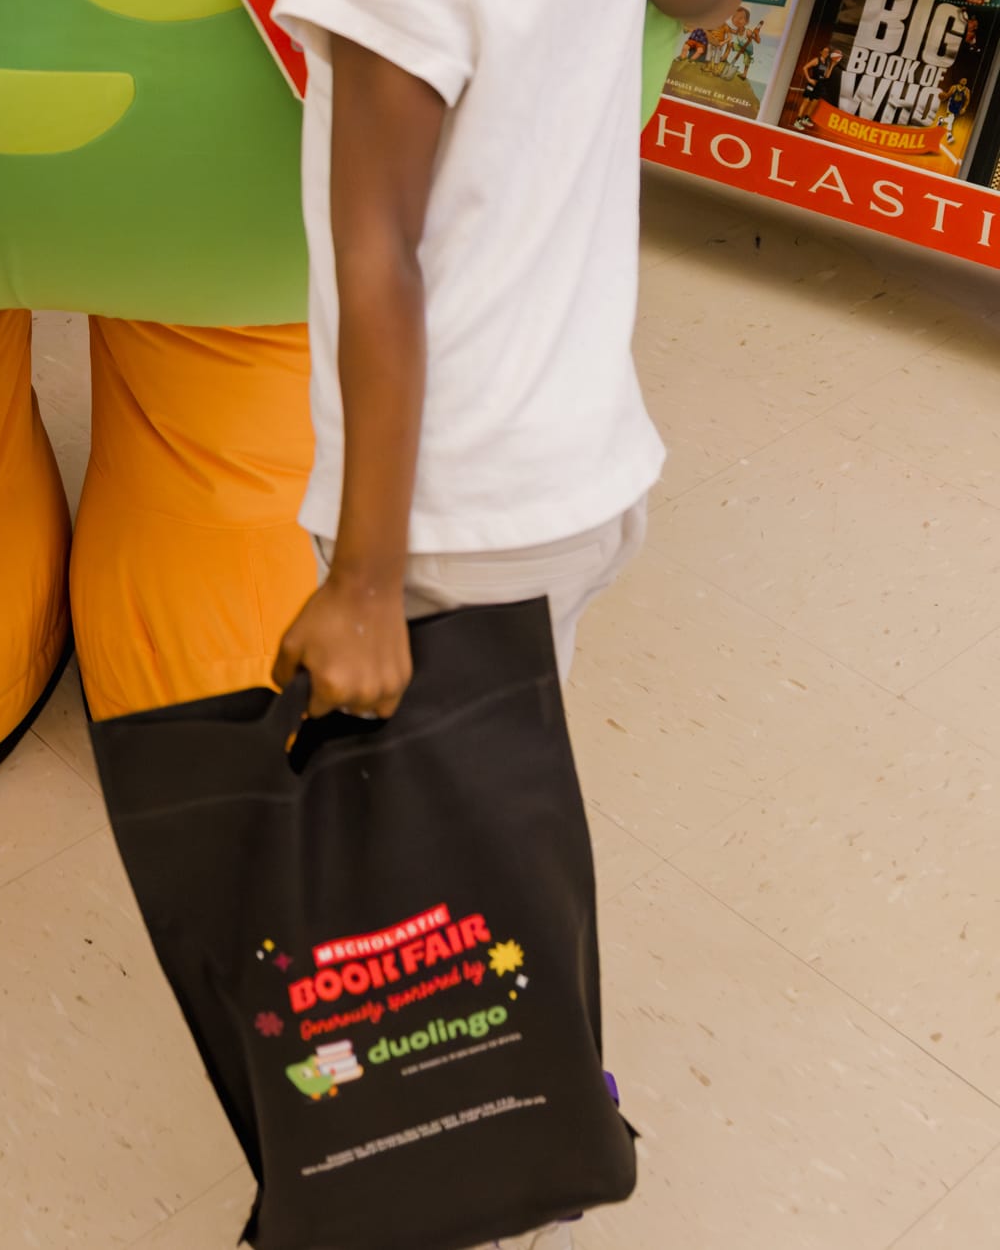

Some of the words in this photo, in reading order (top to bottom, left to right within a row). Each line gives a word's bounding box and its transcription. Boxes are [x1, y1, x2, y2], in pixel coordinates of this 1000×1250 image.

[846, 46, 921, 84] BOOK
[920, 64, 948, 88] OF
[838, 70, 943, 127] WHO
[827, 112, 926, 150] BASKETBALL
[655, 114, 996, 247] HOLASTI
[335, 907, 447, 959] SCHOLASTIC
[288, 951, 401, 1014] BOOK
[400, 912, 492, 975] FAIR
[387, 964, 462, 1012] sponsored
[462, 960, 487, 987] by
[367, 1005, 508, 1065] duolingo
